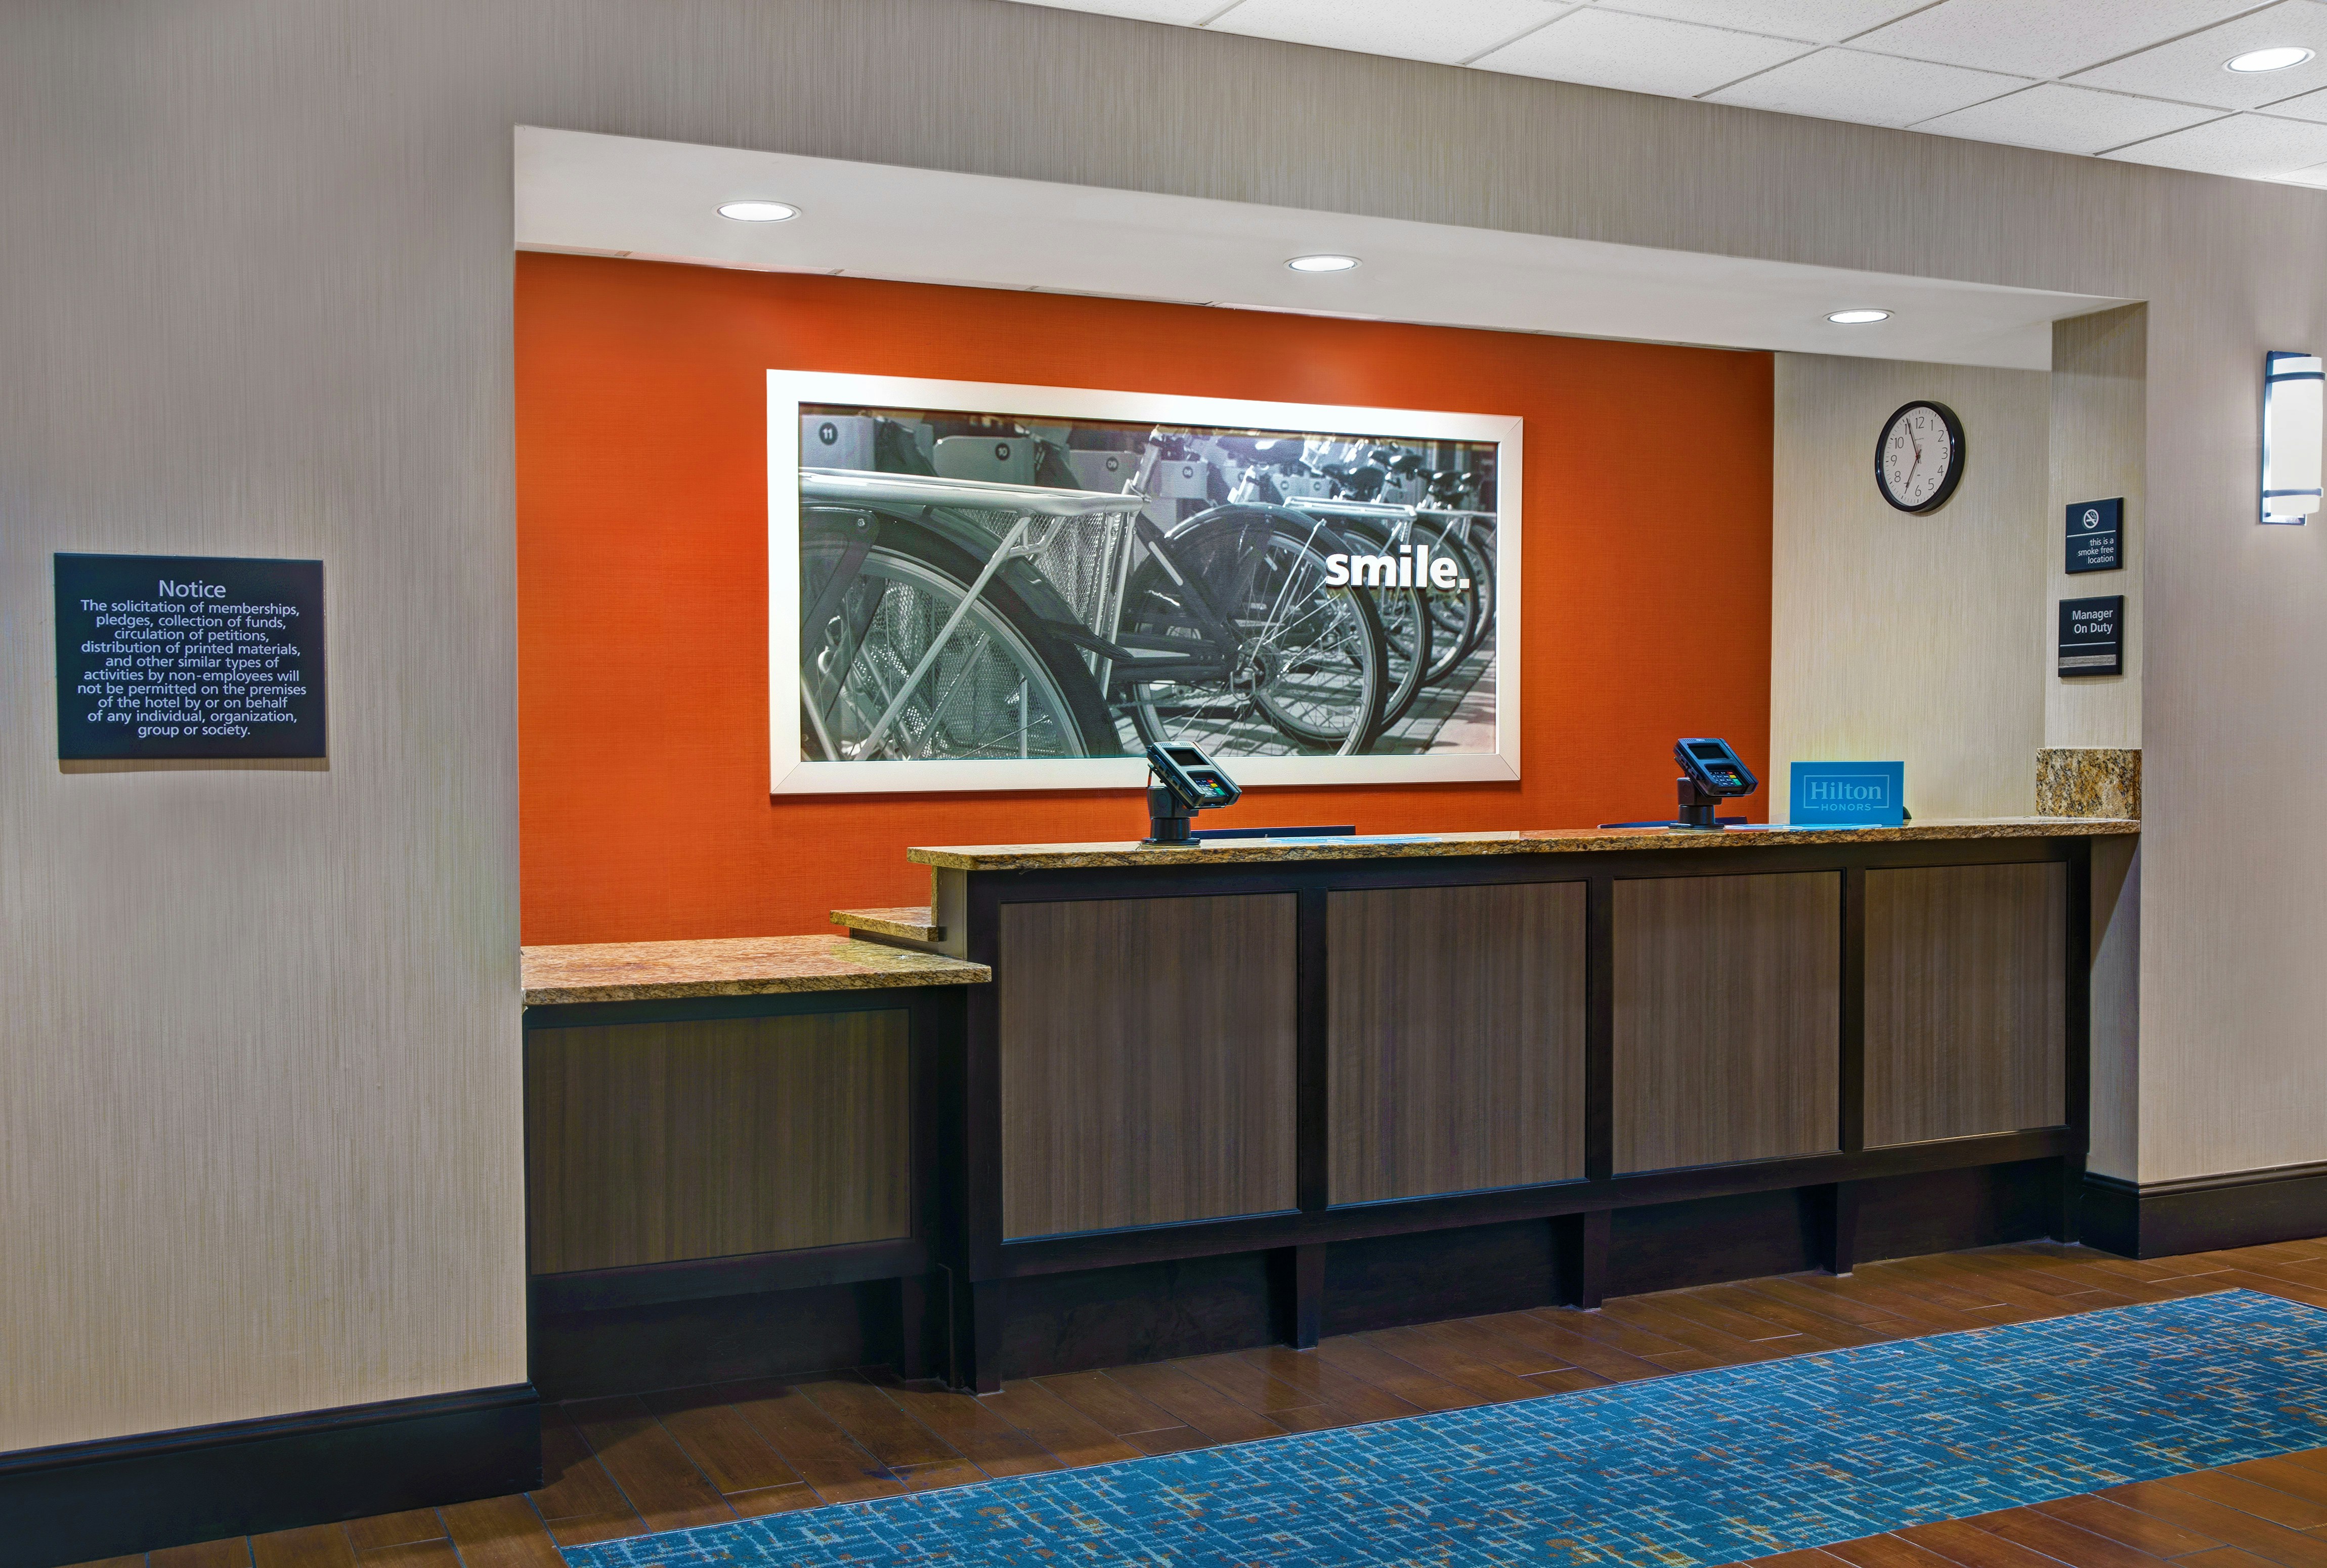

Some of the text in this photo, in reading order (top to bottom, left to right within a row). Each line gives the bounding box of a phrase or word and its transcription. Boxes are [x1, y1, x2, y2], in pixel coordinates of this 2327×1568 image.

[1915, 416, 1924, 429] 12
[1930, 419, 1933, 431] 1
[822, 428, 833, 440] 11
[1937, 430, 1944, 442] 2
[1894, 437, 1904, 449] 10
[1942, 447, 1948, 459] 3
[1890, 454, 1897, 466] 9
[1894, 470, 1901, 483] 8
[1937, 465, 1944, 476] 4
[1915, 485, 1922, 497] 6
[1927, 478, 1934, 491] 5
[2090, 538, 2101, 546] this
[2078, 546, 2114, 556] smoke free
[2087, 555, 2114, 564] location
[1325, 544, 1470, 589] smile.
[159, 580, 226, 598] Notice
[80, 599, 299, 618] The solicitation of memberships,
[2072, 609, 2114, 621] Manager
[96, 613, 286, 630] pledges, collection of funds,
[114, 627, 269, 643] circulation of petitions,
[2074, 622, 2113, 635] On Duty
[81, 640, 300, 657] distribution of printed materials,
[105, 655, 280, 670] and other similar types of
[84, 668, 299, 684] activities by non-employees will
[78, 682, 307, 698] not be permitted on the premises
[98, 695, 288, 711] of the hotel by or on behalf
[88, 709, 297, 725] of any individual, organization,
[138, 723, 250, 738] group or society.
[1810, 781, 1882, 800] Hilton
[1821, 803, 1872, 811] HONORS
